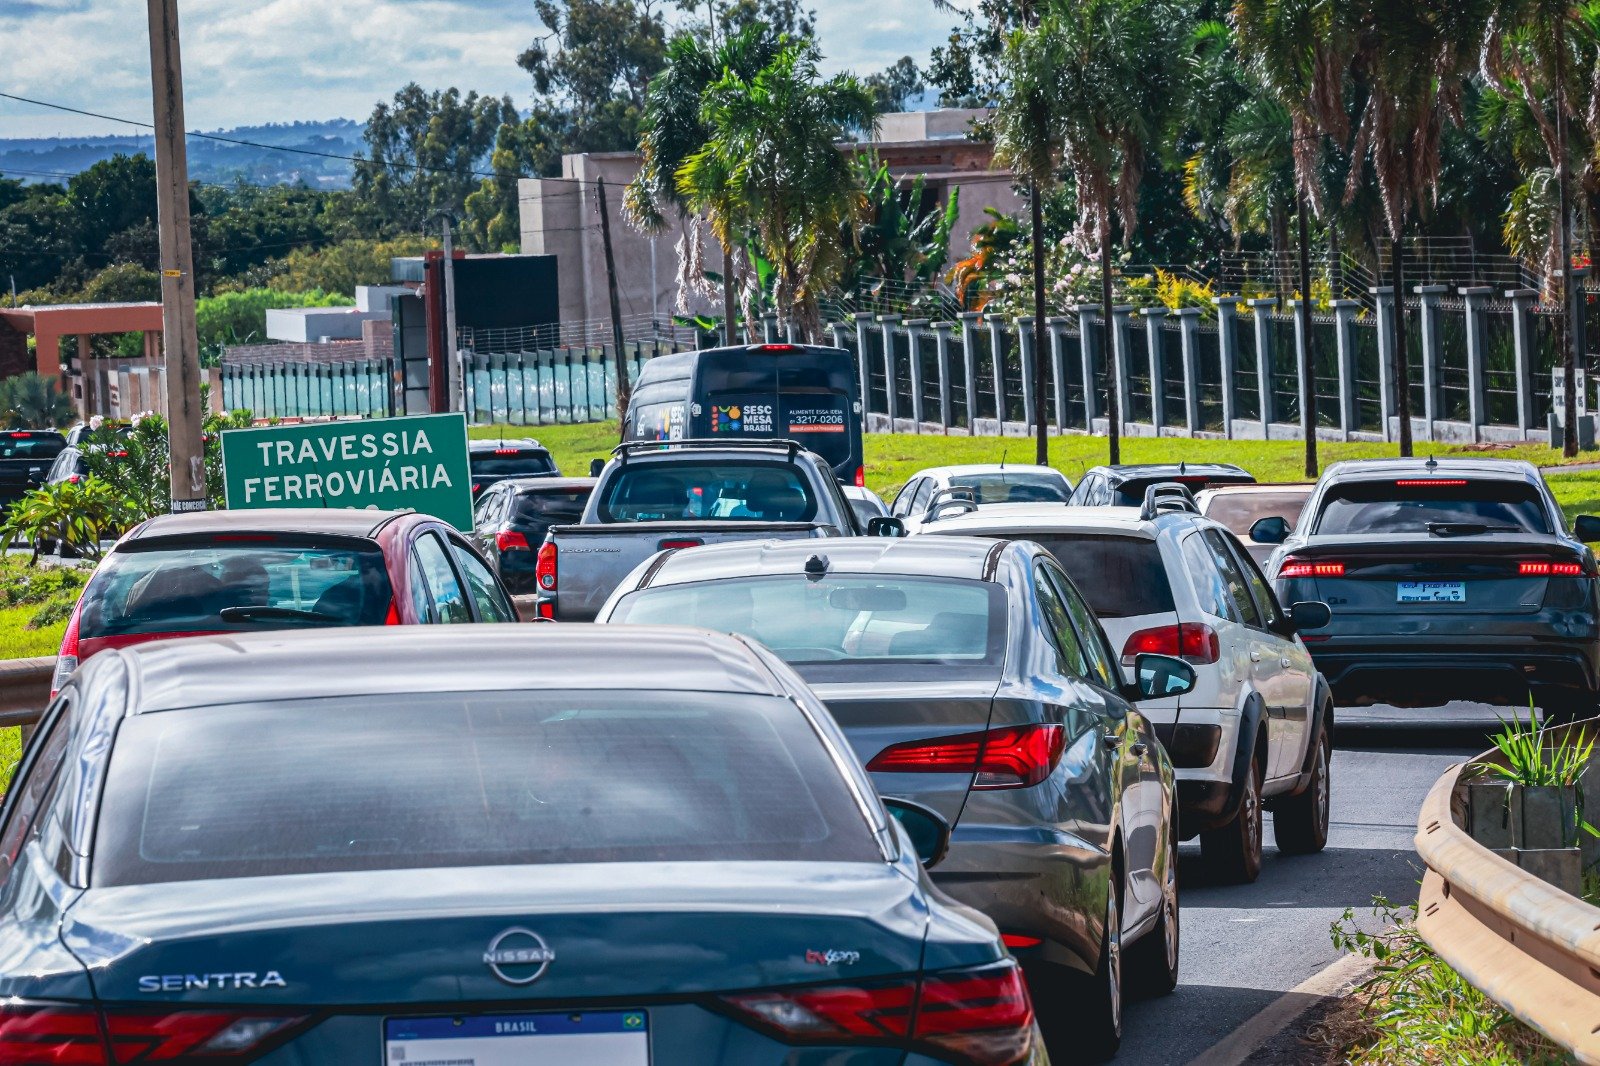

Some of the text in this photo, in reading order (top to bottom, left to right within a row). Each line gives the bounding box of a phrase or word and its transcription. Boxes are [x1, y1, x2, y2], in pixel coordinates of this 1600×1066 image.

[743, 405, 772, 415] SESC
[743, 415, 773, 425] MESA
[796, 415, 843, 424] 3217-0206
[743, 424, 773, 432] BRASIL
[257, 430, 433, 466] TRAVESSIA
[244, 460, 452, 503] FERROVIÁRIA
[483, 950, 556, 964] NISSAN
[138, 970, 287, 992] SENTRA
[495, 1021, 537, 1033] BRASIL
